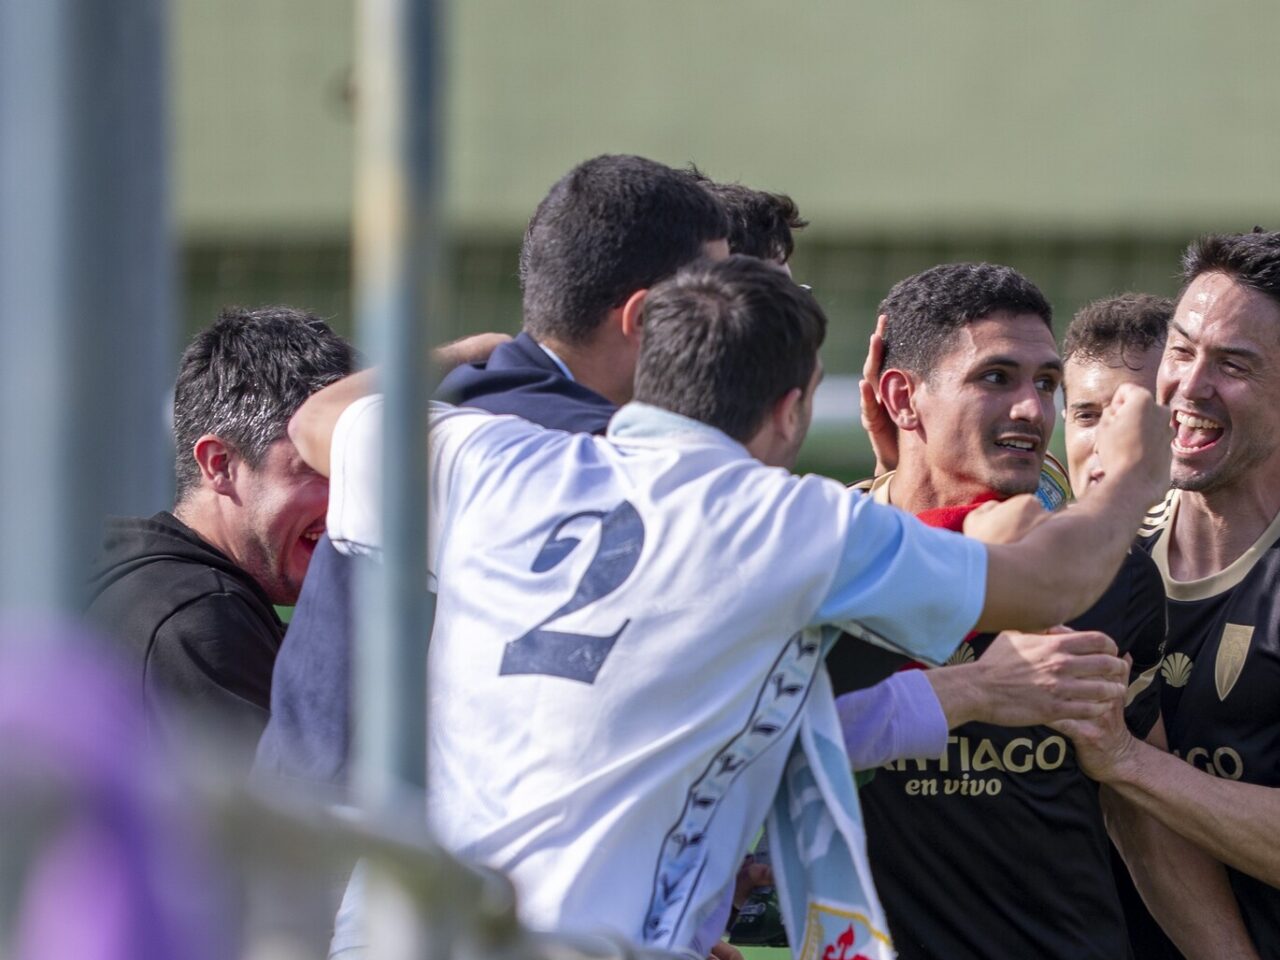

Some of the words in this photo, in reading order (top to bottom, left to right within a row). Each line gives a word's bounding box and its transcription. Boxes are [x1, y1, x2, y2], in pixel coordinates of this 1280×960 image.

[498, 499, 645, 685] 2
[905, 778, 938, 796] en
[944, 773, 1002, 796] vivo
